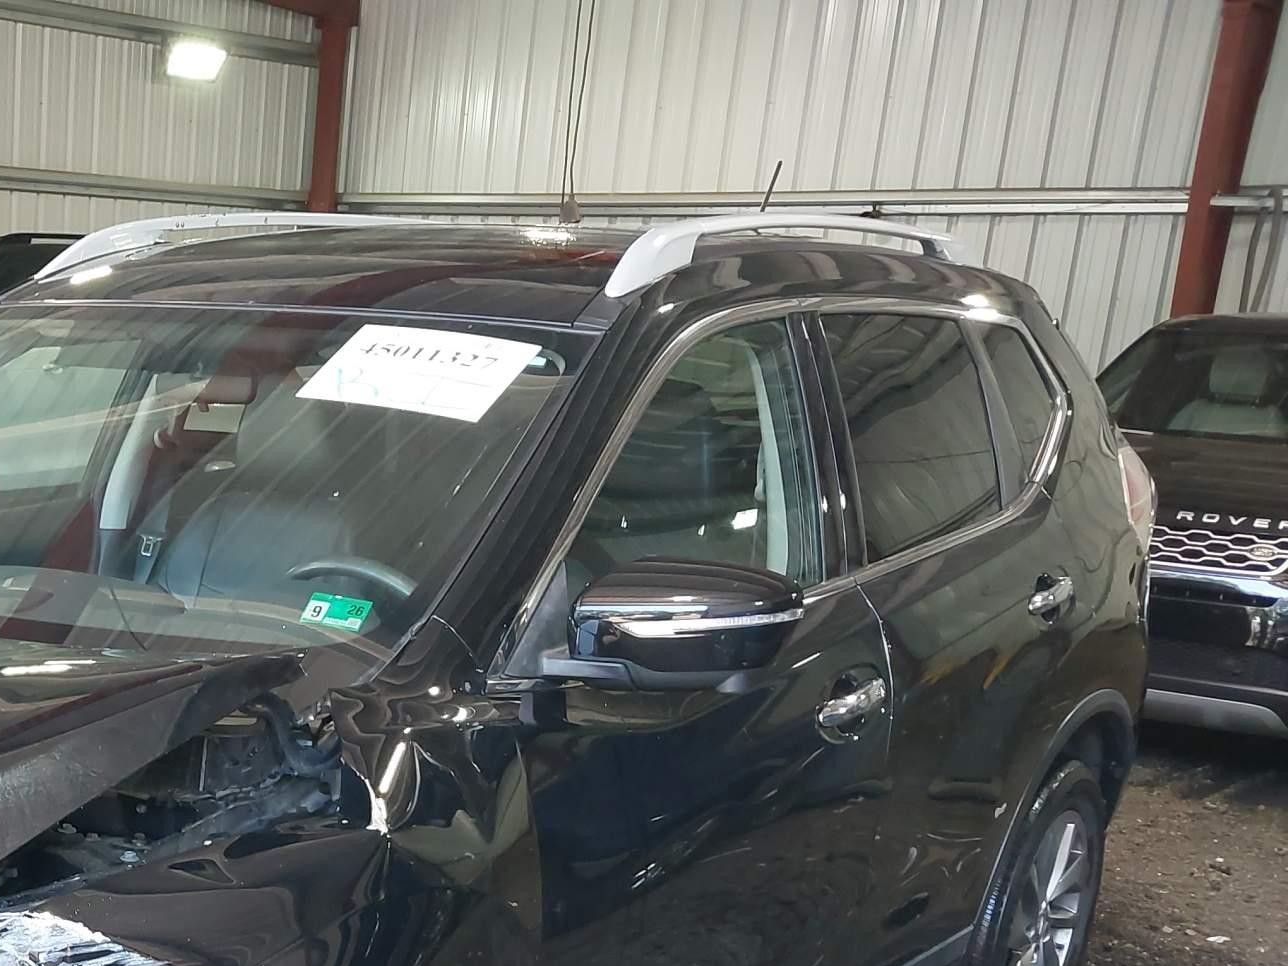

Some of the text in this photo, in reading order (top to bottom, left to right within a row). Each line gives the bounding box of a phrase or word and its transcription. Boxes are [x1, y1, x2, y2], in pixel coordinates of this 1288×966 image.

[360, 343, 499, 369] 45011327
[311, 605, 323, 617] 9
[347, 605, 365, 617] 26
